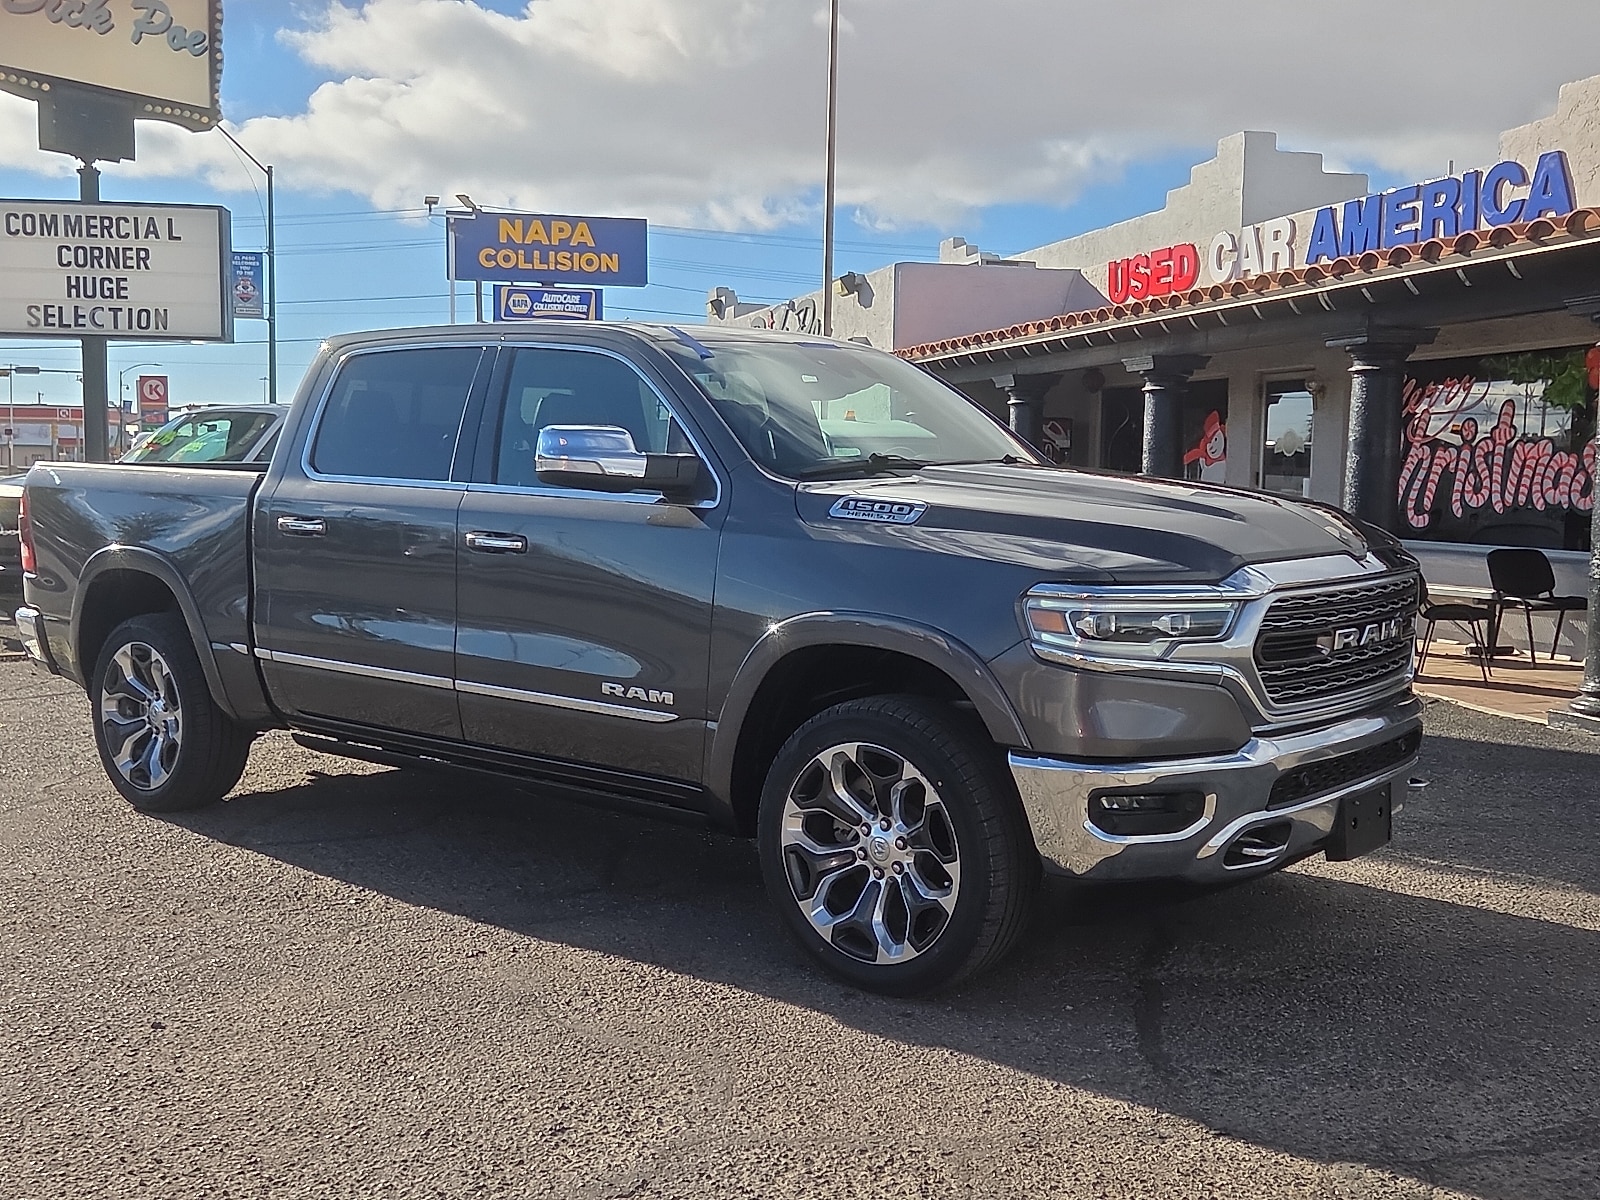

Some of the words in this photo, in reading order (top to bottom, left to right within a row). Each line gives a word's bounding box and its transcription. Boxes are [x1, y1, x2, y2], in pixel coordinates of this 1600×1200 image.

[131, 0, 210, 57] Poe
[4, 211, 183, 242] COMMERCIAL
[498, 217, 596, 247] NAPA
[1107, 243, 1201, 304] USED
[1208, 216, 1296, 282] CAR
[1304, 149, 1578, 265] AMERICA
[57, 244, 151, 270] CORNER
[478, 247, 619, 273] COLLISION
[66, 275, 129, 301] HUGE
[512, 298, 529, 309] NAPA
[533, 302, 564, 312] COLLISION
[564, 303, 588, 313] CENTER
[26, 304, 169, 332] SELECTION
[1398, 399, 1596, 528] hristmas
[847, 500, 911, 514] 1500
[1333, 617, 1401, 650] RAM
[601, 681, 674, 705] RAM
